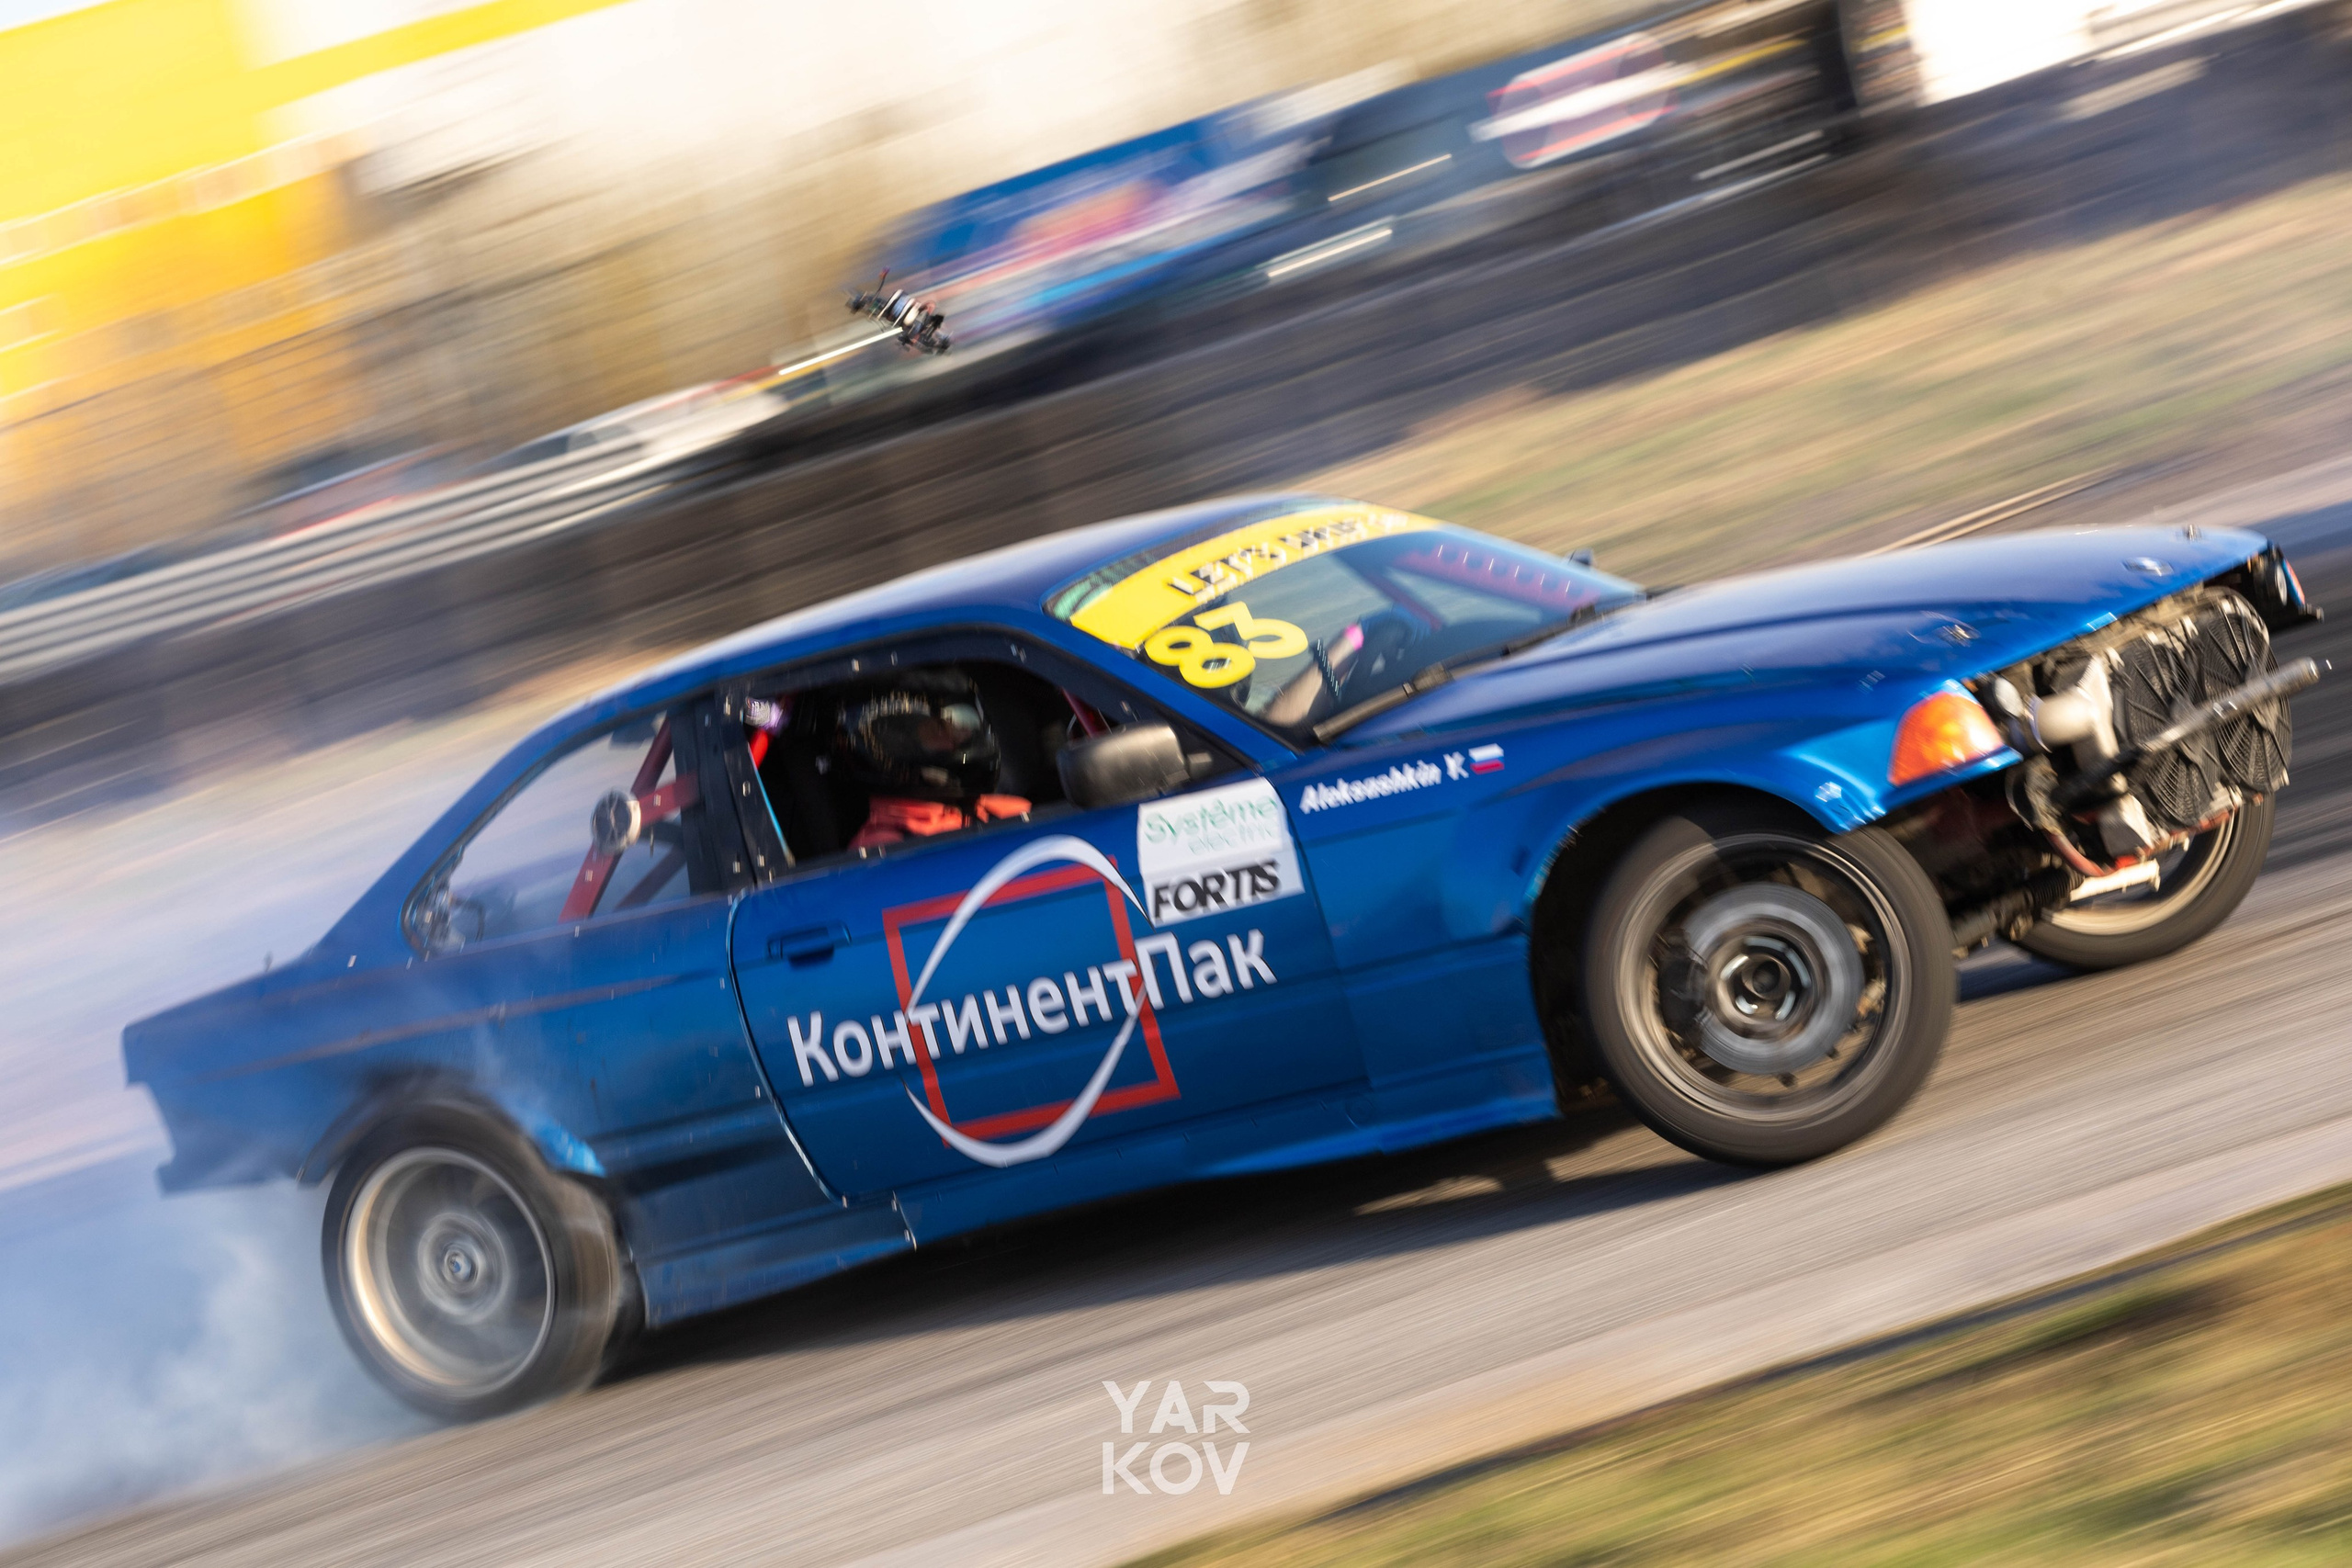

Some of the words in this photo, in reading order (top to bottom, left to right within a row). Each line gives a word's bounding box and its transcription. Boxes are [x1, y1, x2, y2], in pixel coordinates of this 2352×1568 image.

[1145, 601, 1308, 689] 83
[1153, 858, 1282, 921] FORTIS
[786, 929, 1278, 1088] КонтинентПак
